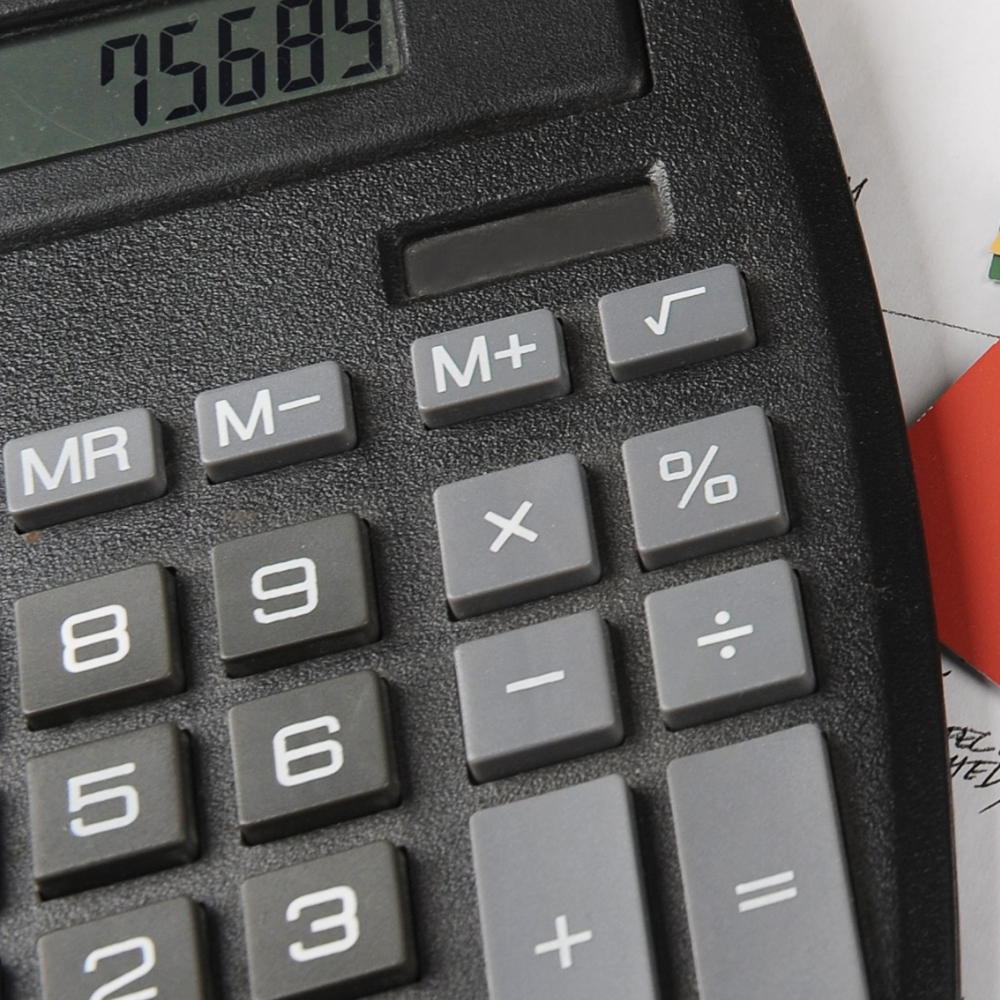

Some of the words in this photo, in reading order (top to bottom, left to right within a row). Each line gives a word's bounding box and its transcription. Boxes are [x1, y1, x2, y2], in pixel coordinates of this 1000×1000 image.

[432, 334, 537, 392] M+
[21, 427, 131, 496] MR
[252, 557, 318, 624] 9
[60, 604, 130, 673] 8
[274, 715, 343, 787] 6
[67, 763, 139, 837] 5
[287, 886, 359, 962] 3
[84, 937, 158, 1000] 2
